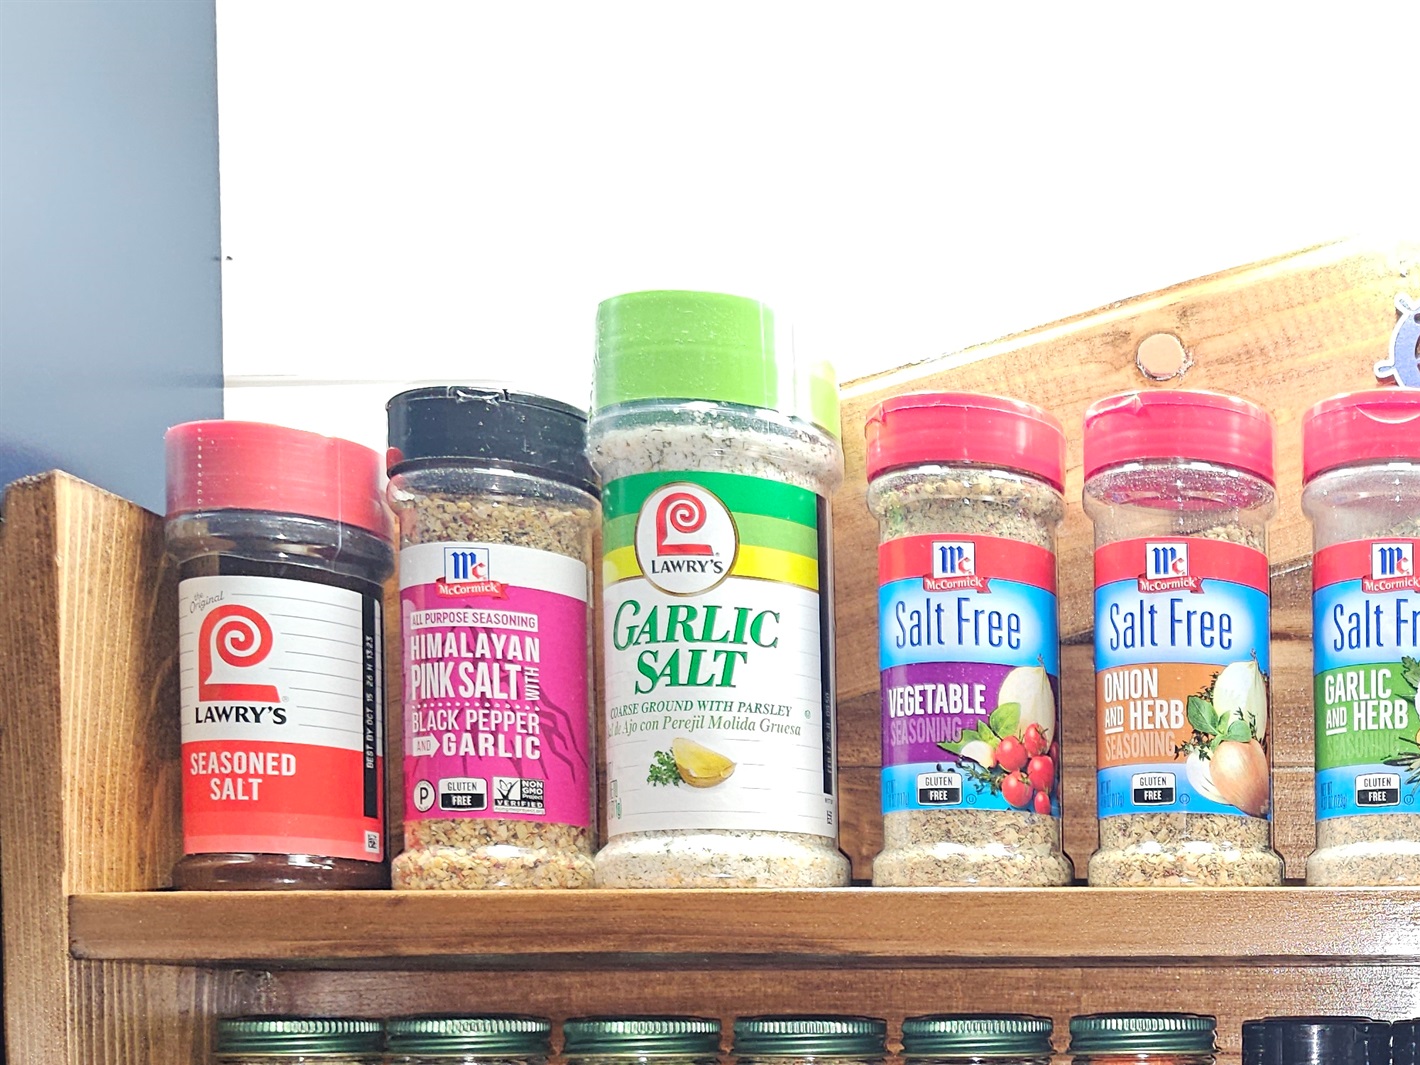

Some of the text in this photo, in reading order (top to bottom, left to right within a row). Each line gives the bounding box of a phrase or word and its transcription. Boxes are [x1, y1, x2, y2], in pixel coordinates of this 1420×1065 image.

[651, 559, 723, 574] LAWRY'S
[439, 583, 498, 596] McCormick
[926, 578, 982, 590] McCormick
[425, 612, 470, 624] PURPOSE
[472, 612, 536, 628] SEASONING
[613, 600, 780, 650] GARLIC
[896, 598, 1020, 650] Salt Free
[411, 632, 540, 663] HIMALAYAN
[411, 661, 539, 700] PINK SALT WITH
[635, 649, 747, 695] SALT
[1105, 668, 1158, 703] ONION
[1325, 669, 1391, 704] GARLIC
[641, 700, 694, 714] GROUND
[697, 700, 733, 713] WITH
[738, 702, 792, 717] PARSLEY
[889, 684, 986, 718] VEGETABLE
[195, 706, 287, 725] LAWRY'S
[412, 710, 540, 734] BLACK PEPPER
[640, 717, 659, 732] con
[663, 715, 705, 732] Perejil
[708, 716, 756, 732] Molida
[1105, 701, 1184, 730] AND HERB
[1326, 700, 1408, 731] AND HERB
[417, 733, 540, 760] AND GARLIC
[190, 752, 296, 776] SEASONED
[210, 778, 262, 800] SALT
[448, 781, 477, 791] GLUTEN
[452, 794, 472, 806] FREE
